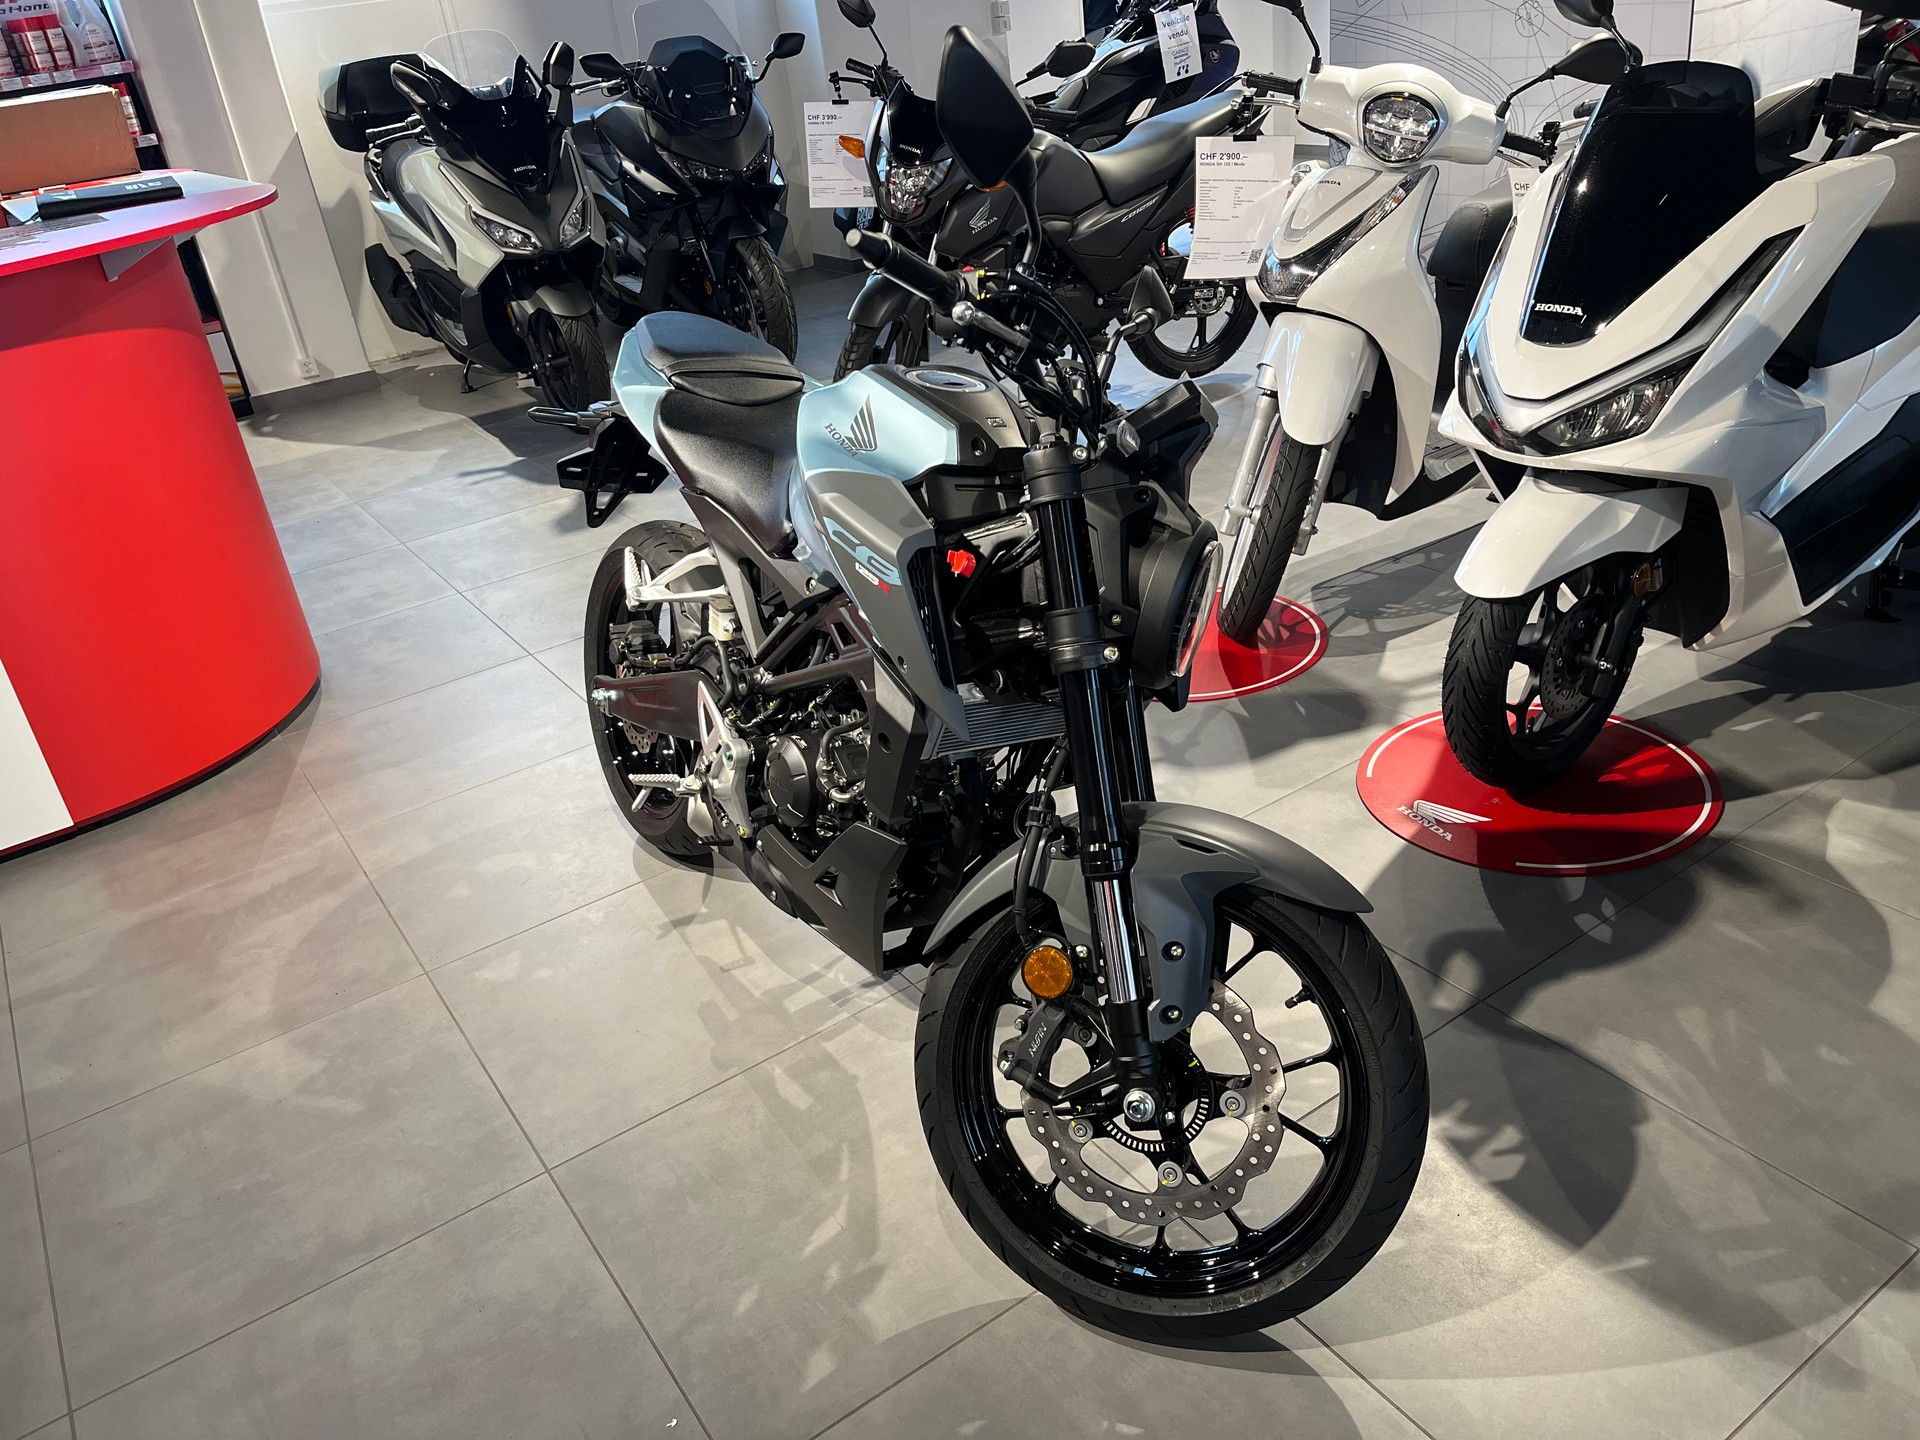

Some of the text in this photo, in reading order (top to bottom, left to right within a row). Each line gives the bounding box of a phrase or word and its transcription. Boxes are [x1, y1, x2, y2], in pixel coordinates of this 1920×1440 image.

[1168, 29, 1189, 40] vendu
[899, 144, 921, 155] HONDA
[1200, 152, 1217, 161] CHF
[513, 165, 537, 173] HONDA
[1514, 182, 1530, 191] CHF
[972, 216, 998, 235] HONDA
[1534, 303, 1584, 316] HONDA
[824, 422, 858, 458] HONDA
[1396, 805, 1453, 842] HONDA
